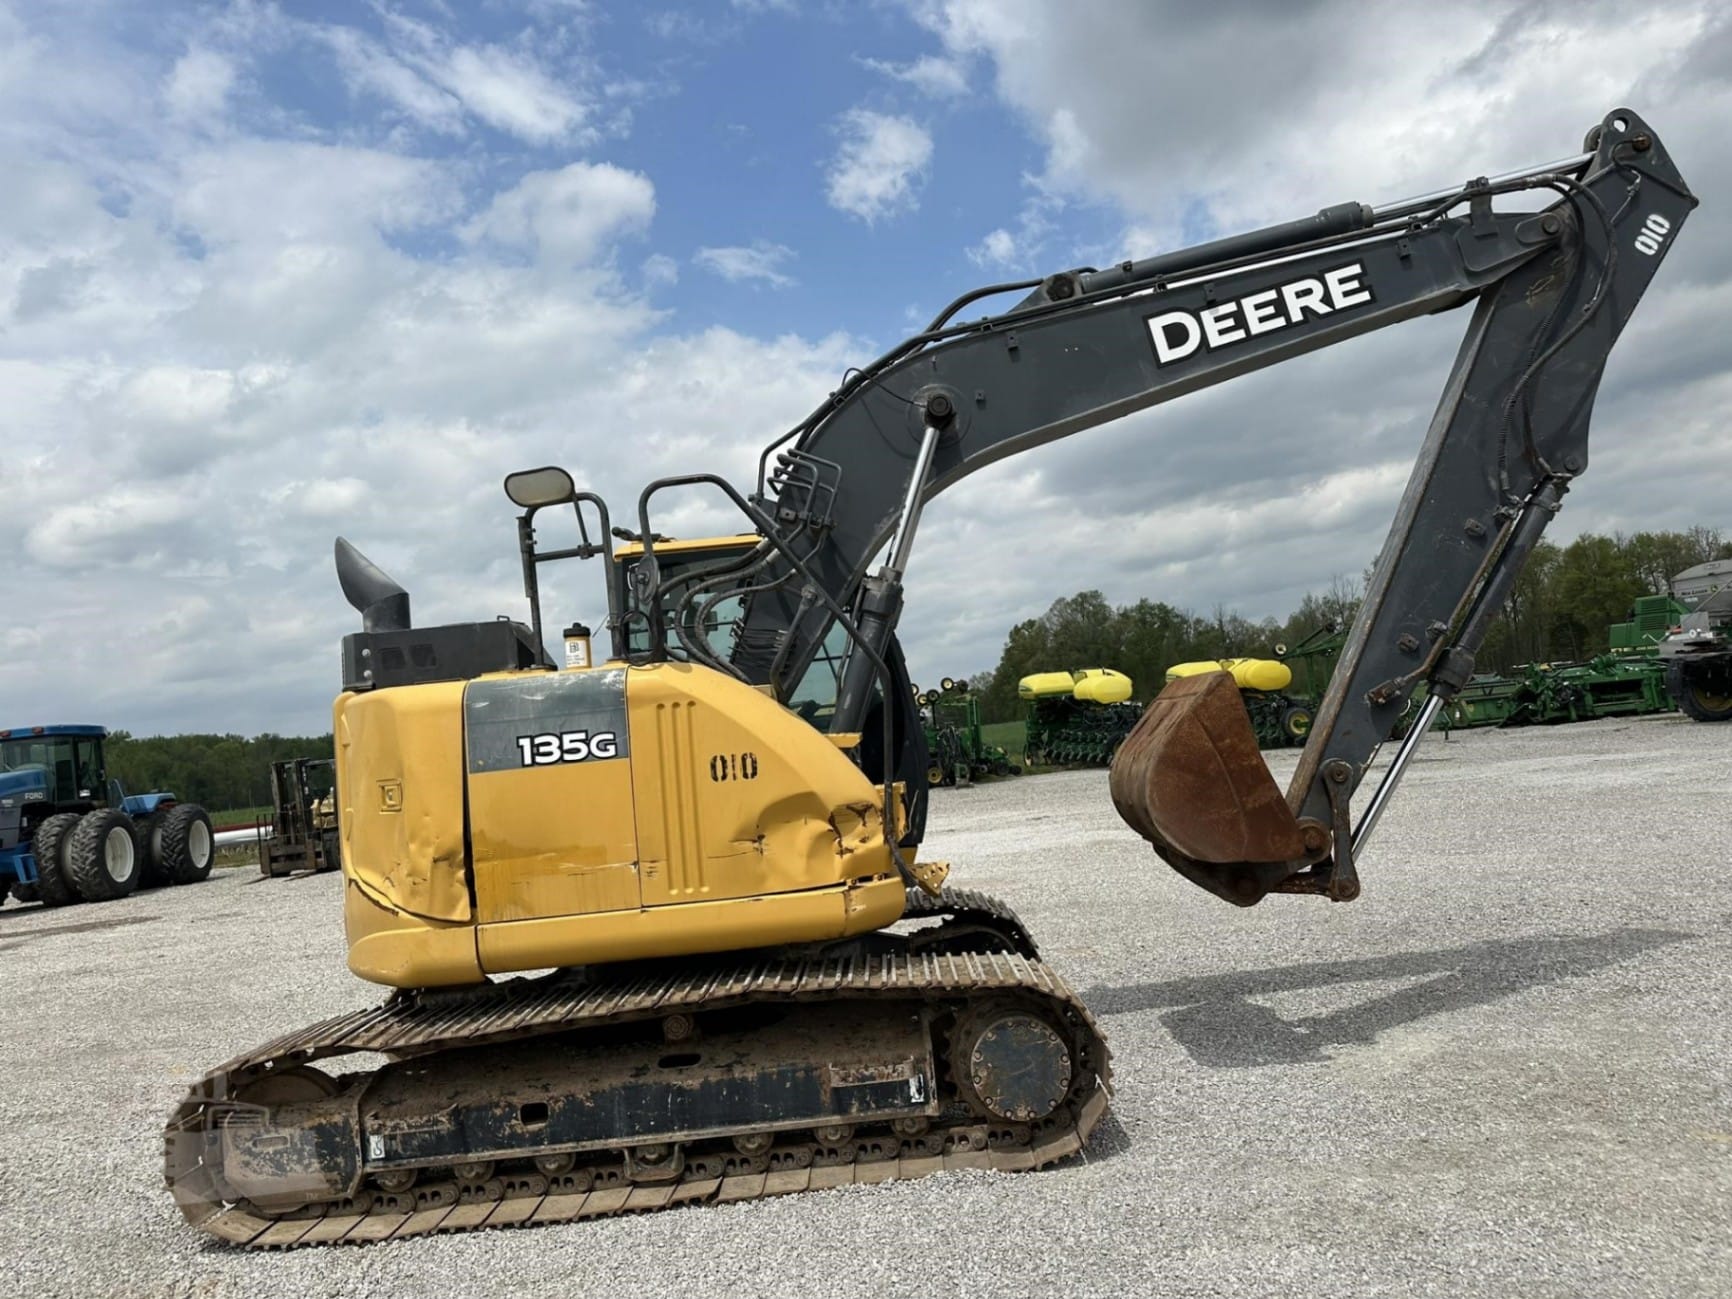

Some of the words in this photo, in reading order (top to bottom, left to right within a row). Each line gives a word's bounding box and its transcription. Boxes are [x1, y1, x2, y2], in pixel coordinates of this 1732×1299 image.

[1634, 213, 1671, 256] 010
[1148, 264, 1371, 364] DEERE
[517, 730, 618, 767] 135G
[710, 752, 758, 782] 010
